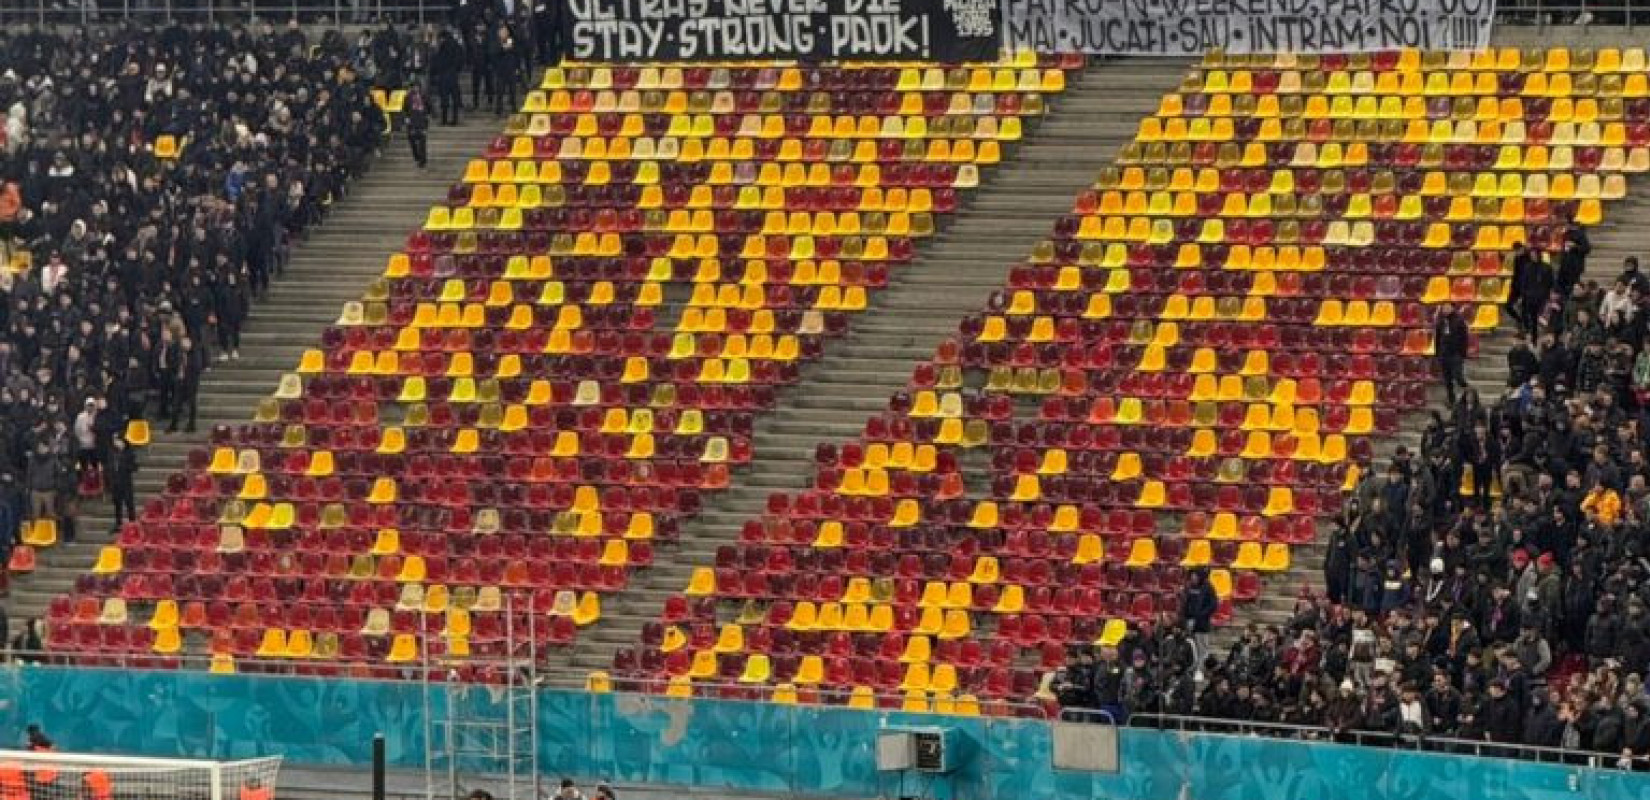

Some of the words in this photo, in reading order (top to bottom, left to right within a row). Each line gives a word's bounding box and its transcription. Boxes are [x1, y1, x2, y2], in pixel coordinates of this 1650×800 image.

[573, 19, 664, 59] STAY
[679, 15, 814, 58] STRONG
[831, 14, 929, 58] PAOK!
[1179, 16, 1230, 52] SAU
